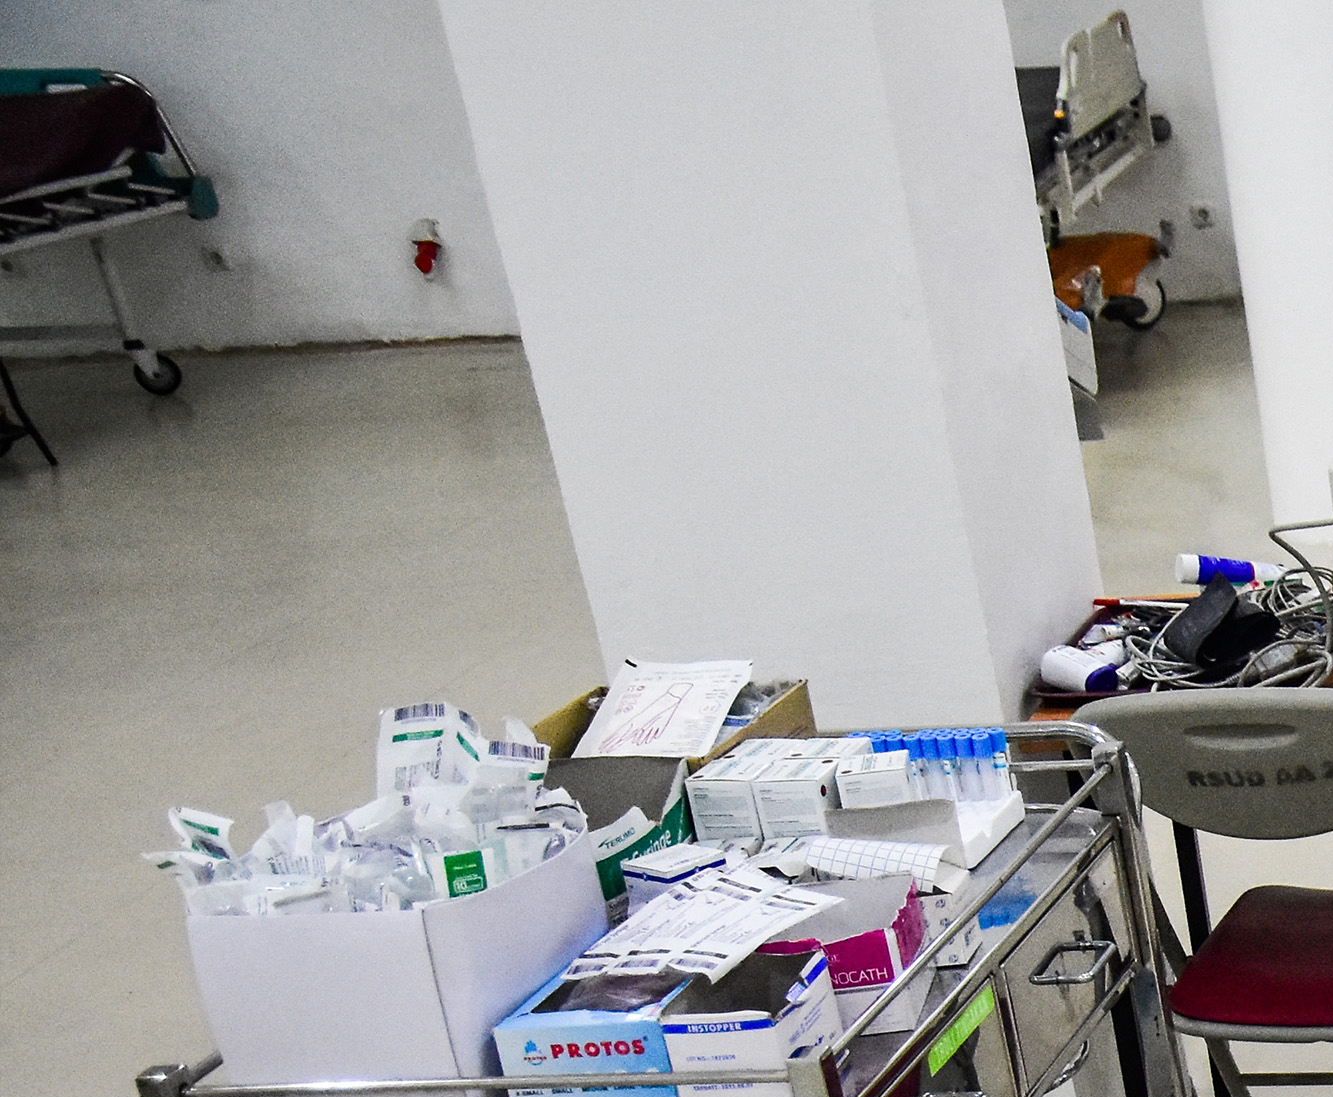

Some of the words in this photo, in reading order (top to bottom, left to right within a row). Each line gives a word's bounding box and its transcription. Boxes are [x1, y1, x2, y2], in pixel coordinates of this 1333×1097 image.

[1187, 770, 1265, 787] RSUD
[1276, 765, 1317, 785] AA
[604, 827, 635, 849] TERUMO
[688, 1022, 742, 1033] INSTOPPER
[550, 1039, 645, 1060] PROTOS
